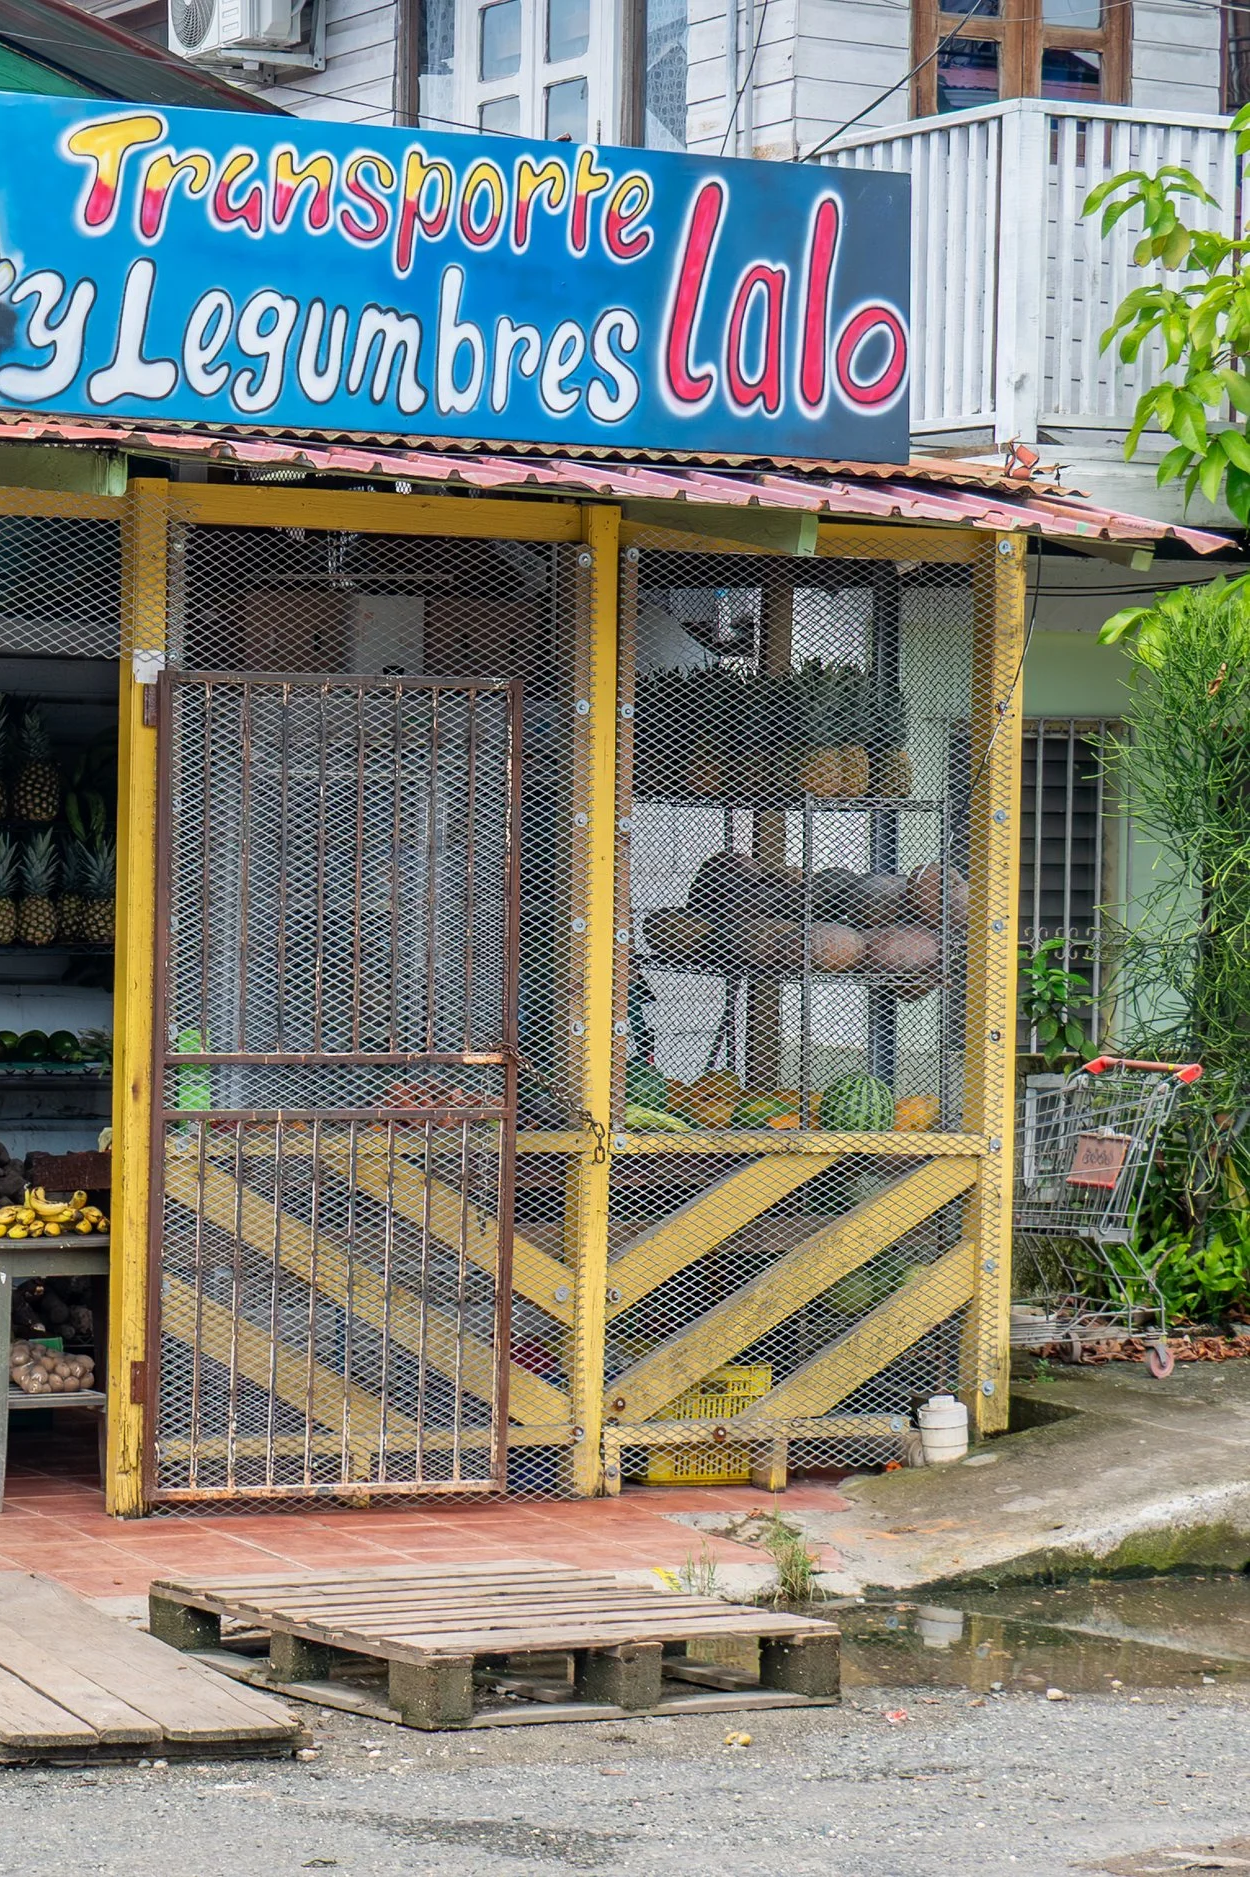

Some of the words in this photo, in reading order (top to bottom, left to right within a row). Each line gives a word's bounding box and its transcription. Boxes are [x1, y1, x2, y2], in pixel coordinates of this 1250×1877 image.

[67, 114, 652, 274] Transporte
[87, 257, 641, 424] Legumbres
[664, 179, 909, 417] lalo
